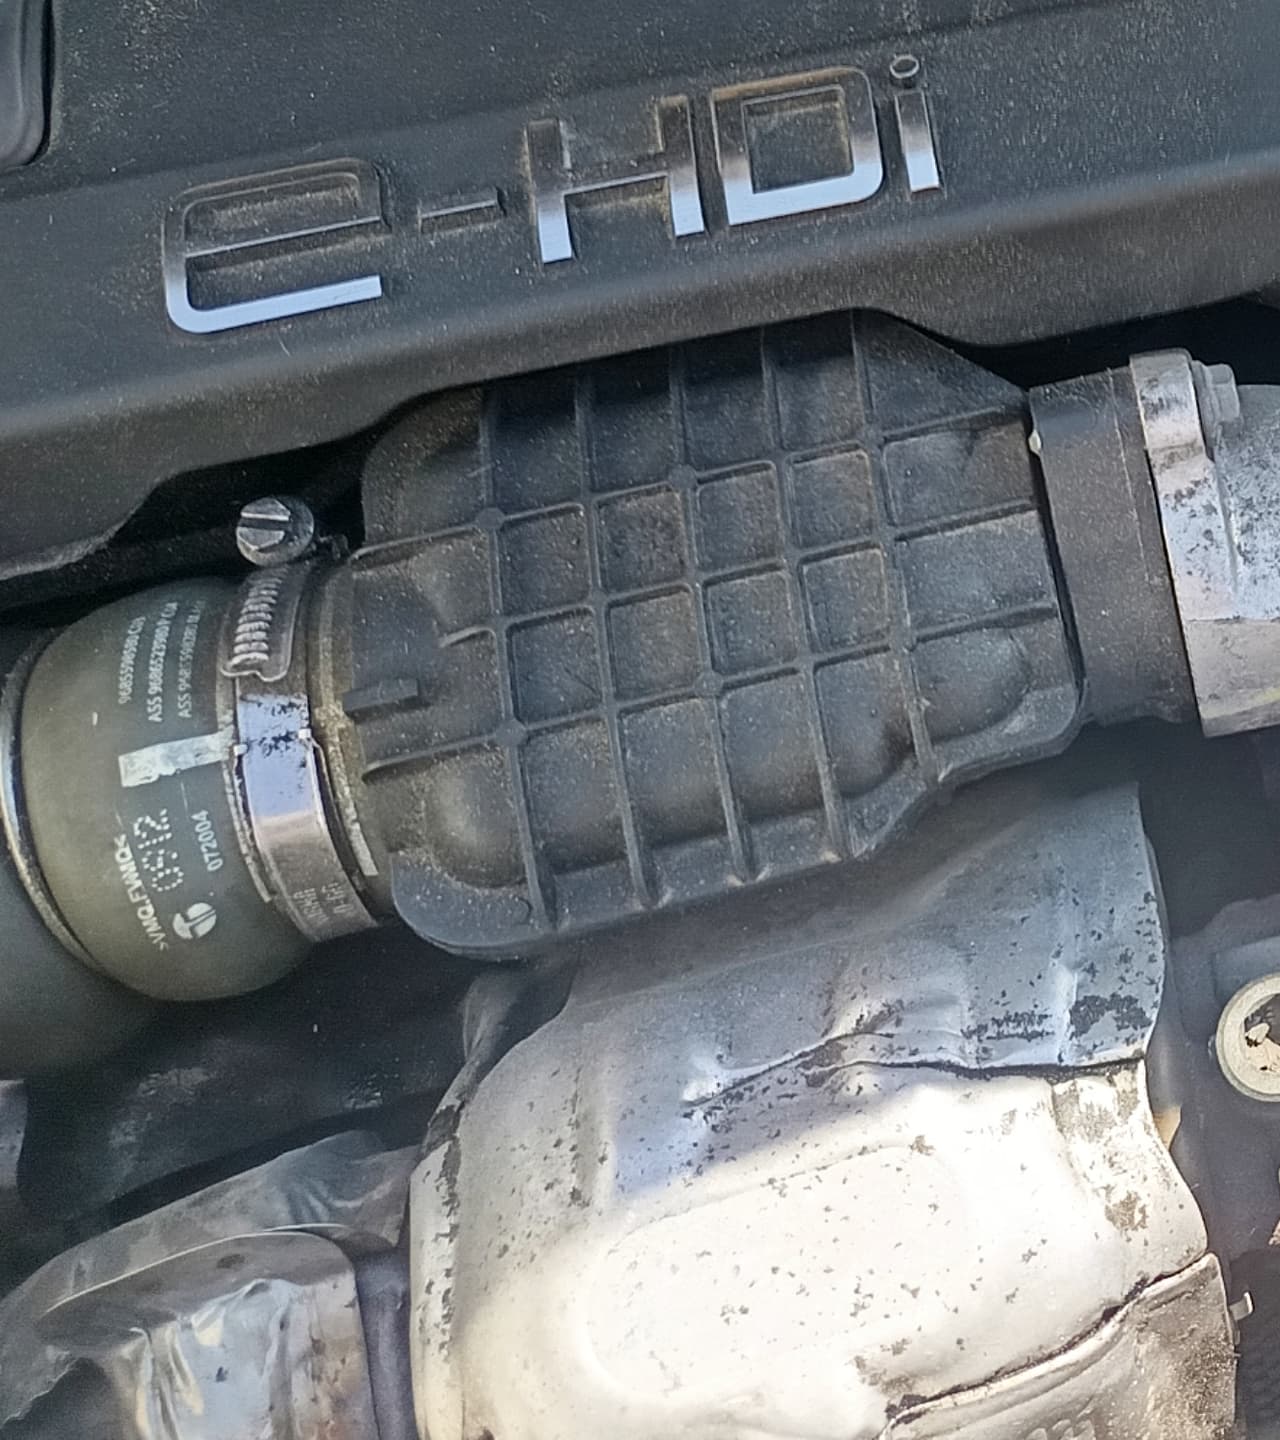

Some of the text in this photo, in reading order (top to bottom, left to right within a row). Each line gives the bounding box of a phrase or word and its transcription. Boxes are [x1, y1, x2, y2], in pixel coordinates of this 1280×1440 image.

[162, 54, 942, 335] e-HDi
[147, 696, 162, 722] ASS
[178, 693, 192, 718] ASS
[190, 809, 223, 872] 072004
